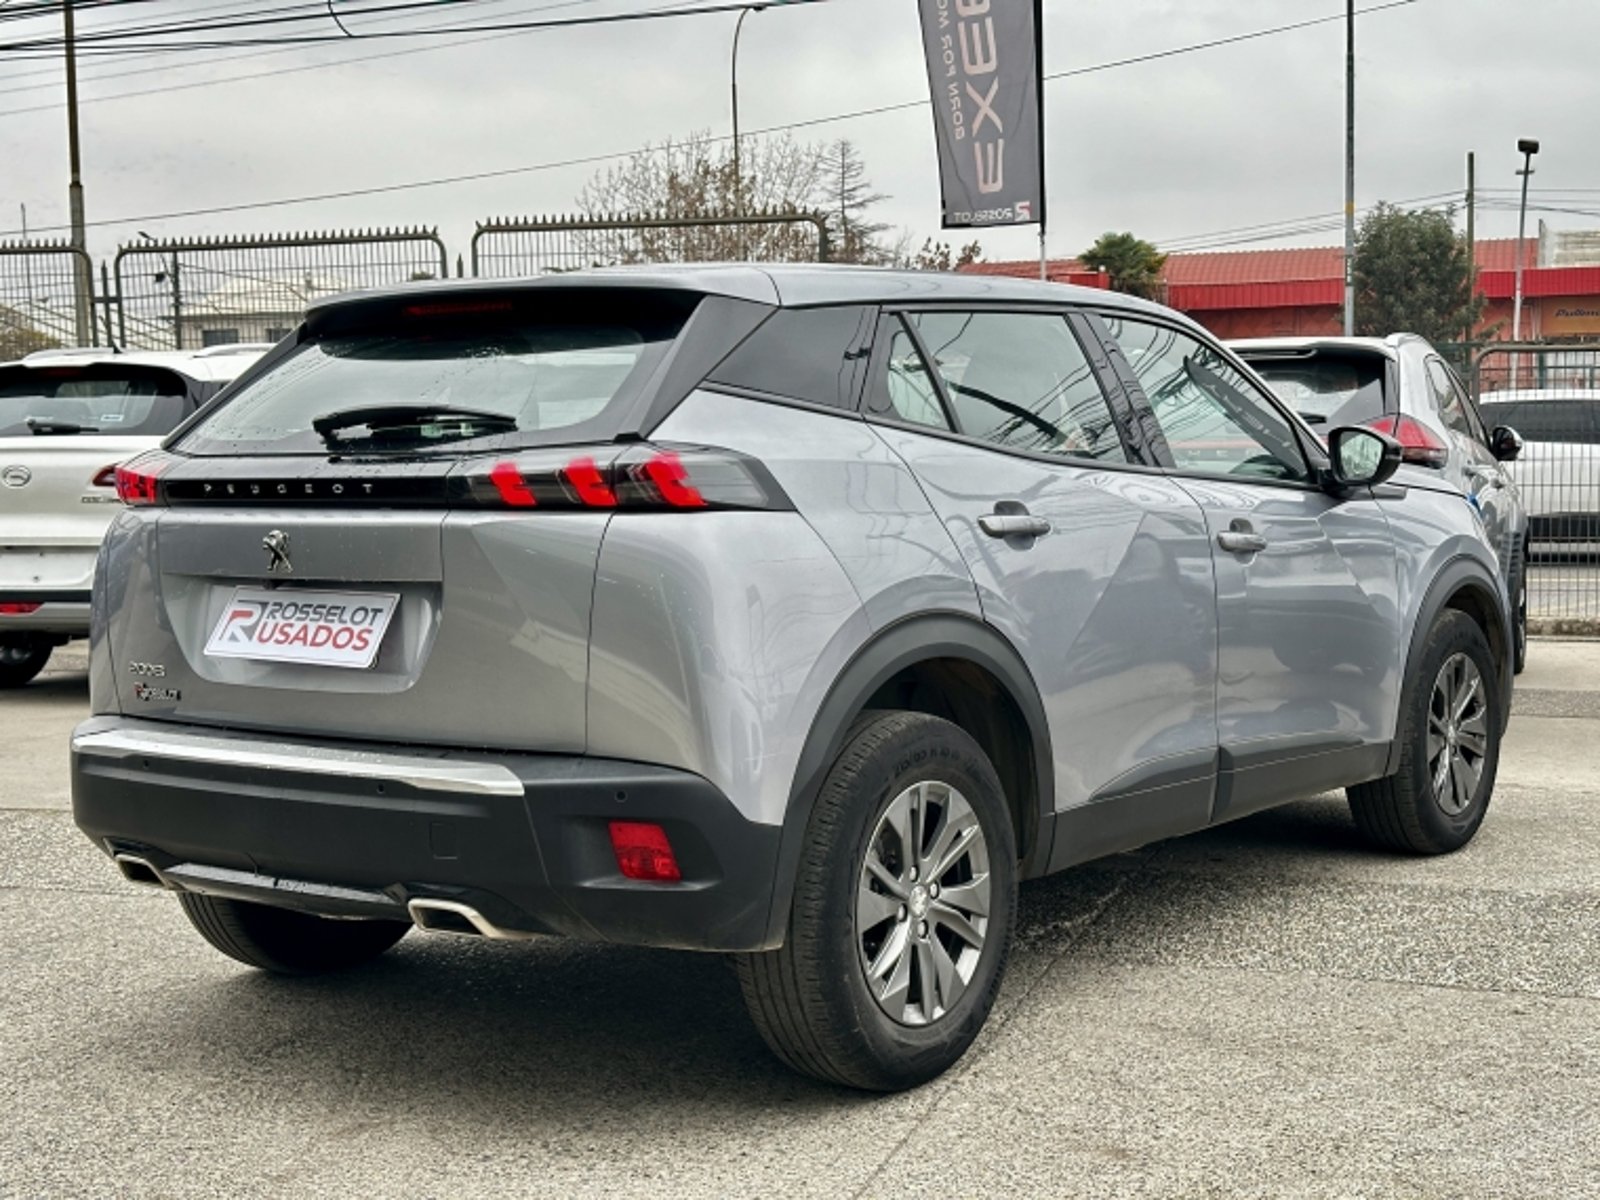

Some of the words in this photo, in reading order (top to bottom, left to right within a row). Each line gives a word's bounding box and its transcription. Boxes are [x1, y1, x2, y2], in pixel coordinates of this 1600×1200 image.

[203, 483, 373, 494] PEUGEOT
[266, 602, 383, 626] ROSSELOT
[257, 621, 373, 651] USADOS
